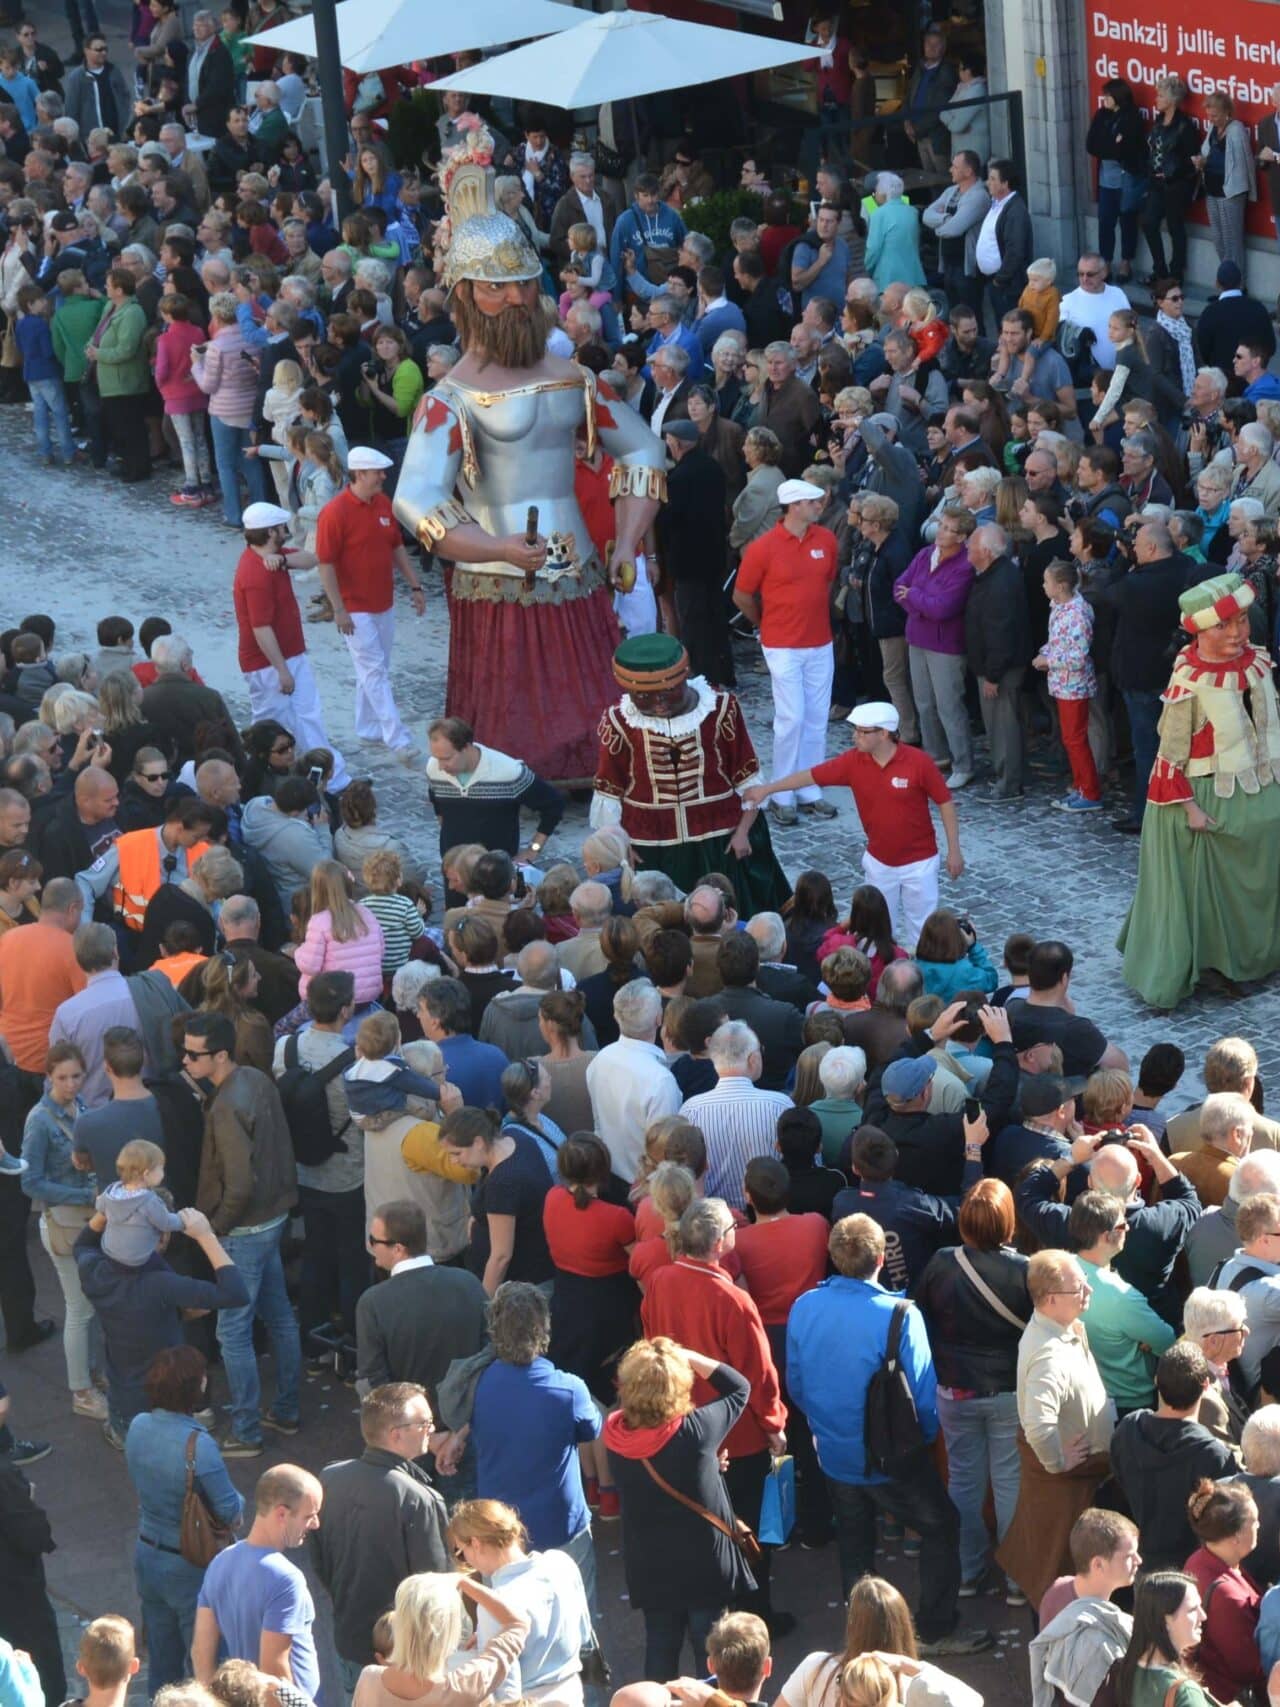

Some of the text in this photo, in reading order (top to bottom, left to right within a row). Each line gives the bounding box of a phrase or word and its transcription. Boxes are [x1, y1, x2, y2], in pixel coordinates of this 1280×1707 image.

[1093, 12, 1168, 53] Dankzij
[1176, 26, 1226, 58] jullie
[1095, 53, 1119, 79] de
